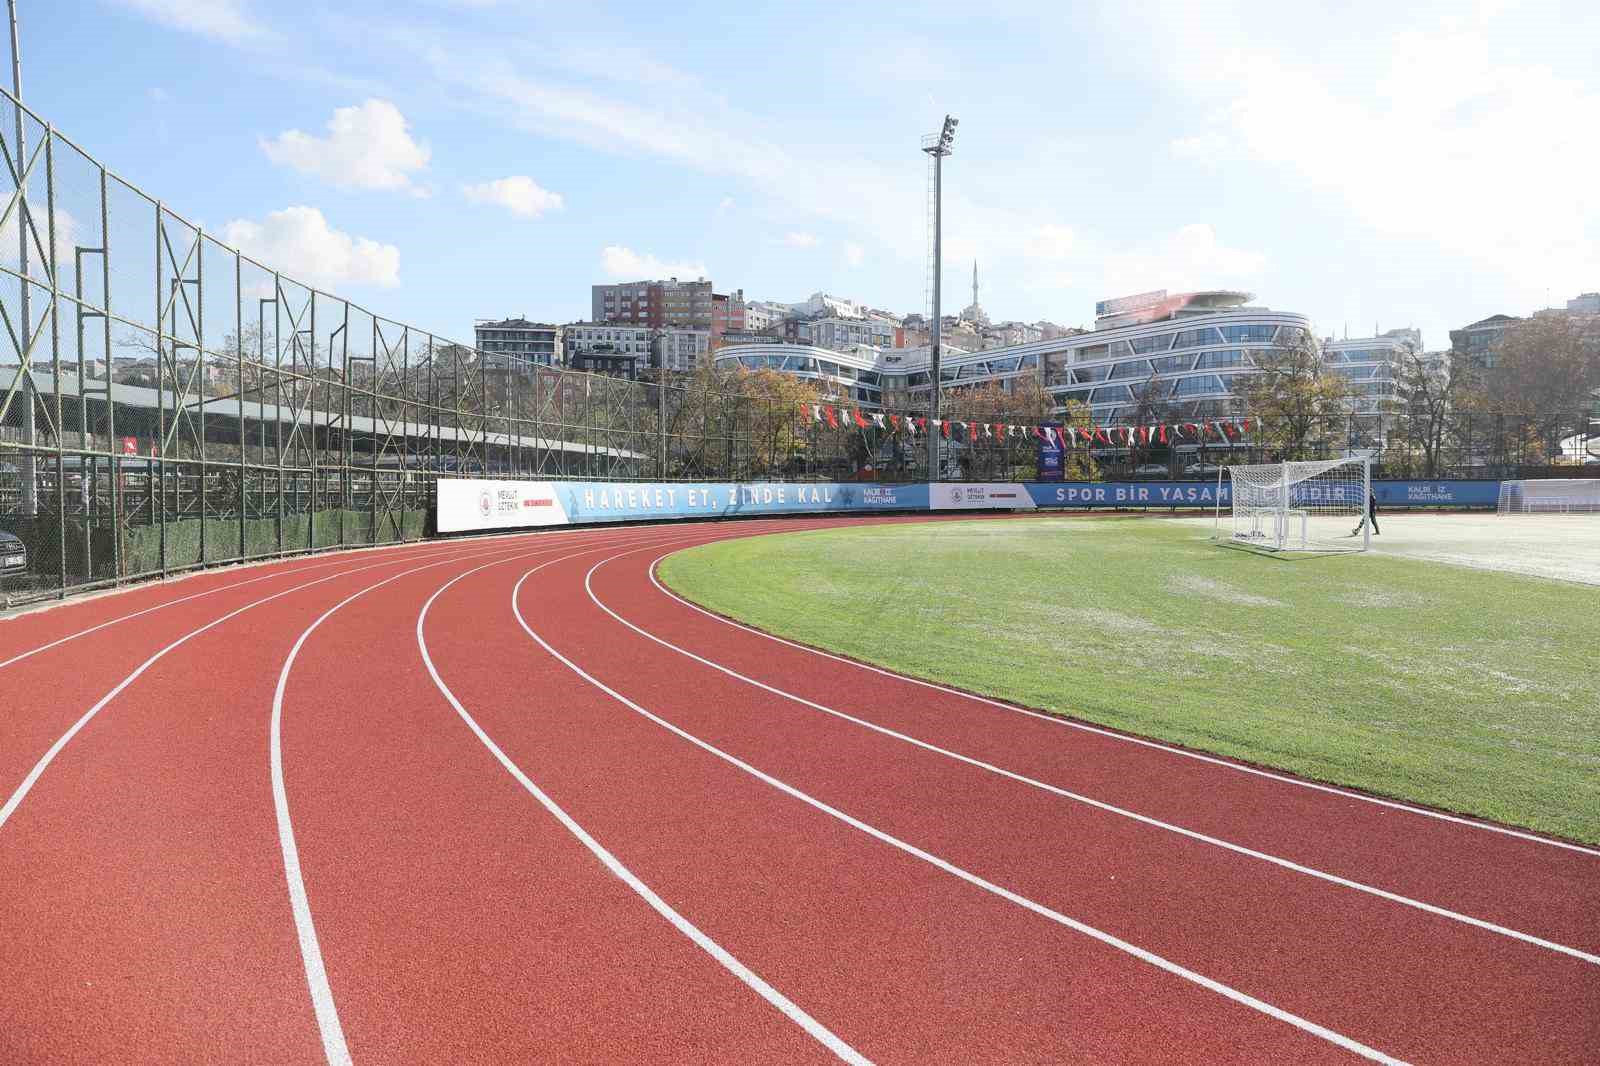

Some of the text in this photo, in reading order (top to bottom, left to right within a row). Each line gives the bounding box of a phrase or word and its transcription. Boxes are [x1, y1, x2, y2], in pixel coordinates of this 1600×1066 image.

[585, 489, 675, 511] HAREKET
[688, 489, 717, 509] ET,
[798, 487, 832, 503] KAL
[1056, 487, 1105, 501] SPOR
[1116, 485, 1149, 501] BİR
[1160, 487, 1228, 502] YAŞAM
